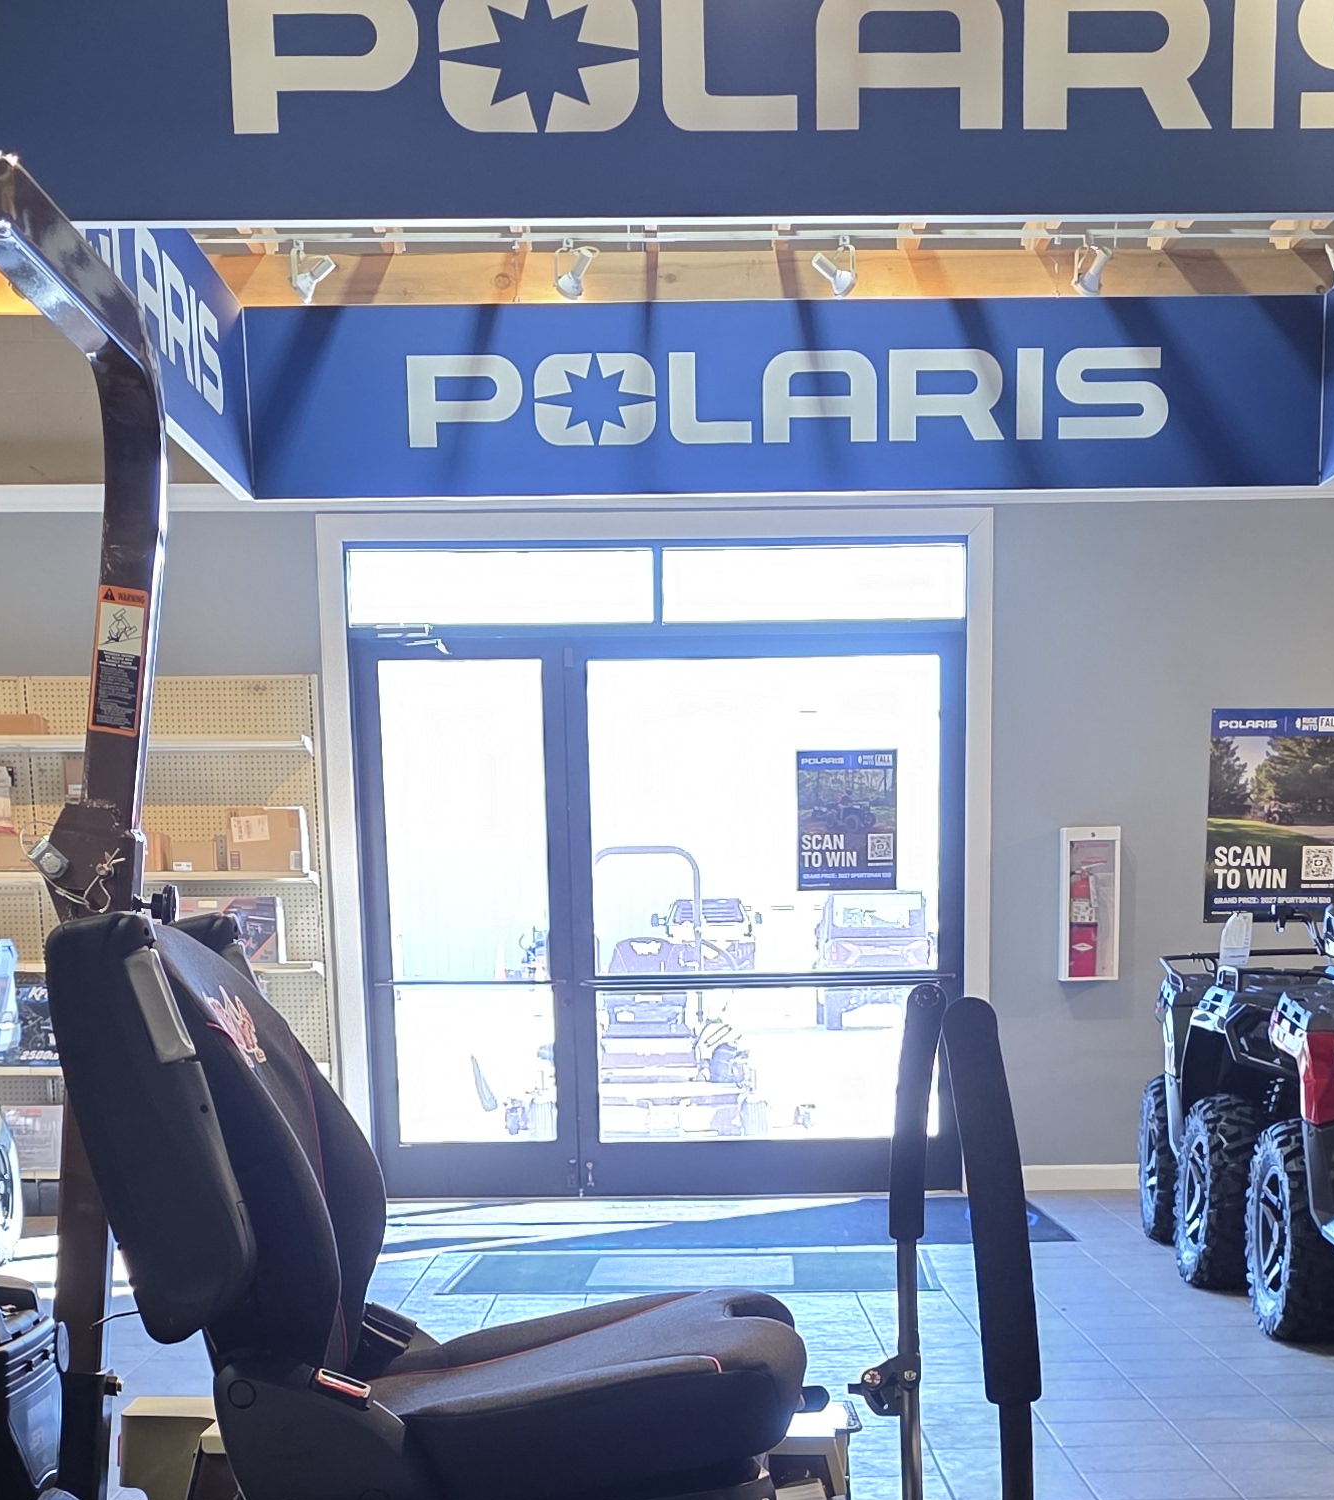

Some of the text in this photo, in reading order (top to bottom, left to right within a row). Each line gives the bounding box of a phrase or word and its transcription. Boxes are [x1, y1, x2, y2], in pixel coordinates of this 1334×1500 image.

[406, 347, 1170, 447] POLARIS
[1219, 720, 1278, 729] POLARIS
[801, 757, 844, 765] POLARIS
[801, 834, 844, 850] SCAN
[801, 851, 857, 867] TO WIN
[1214, 845, 1271, 867] SCAN
[1214, 868, 1287, 889] TO WIN
